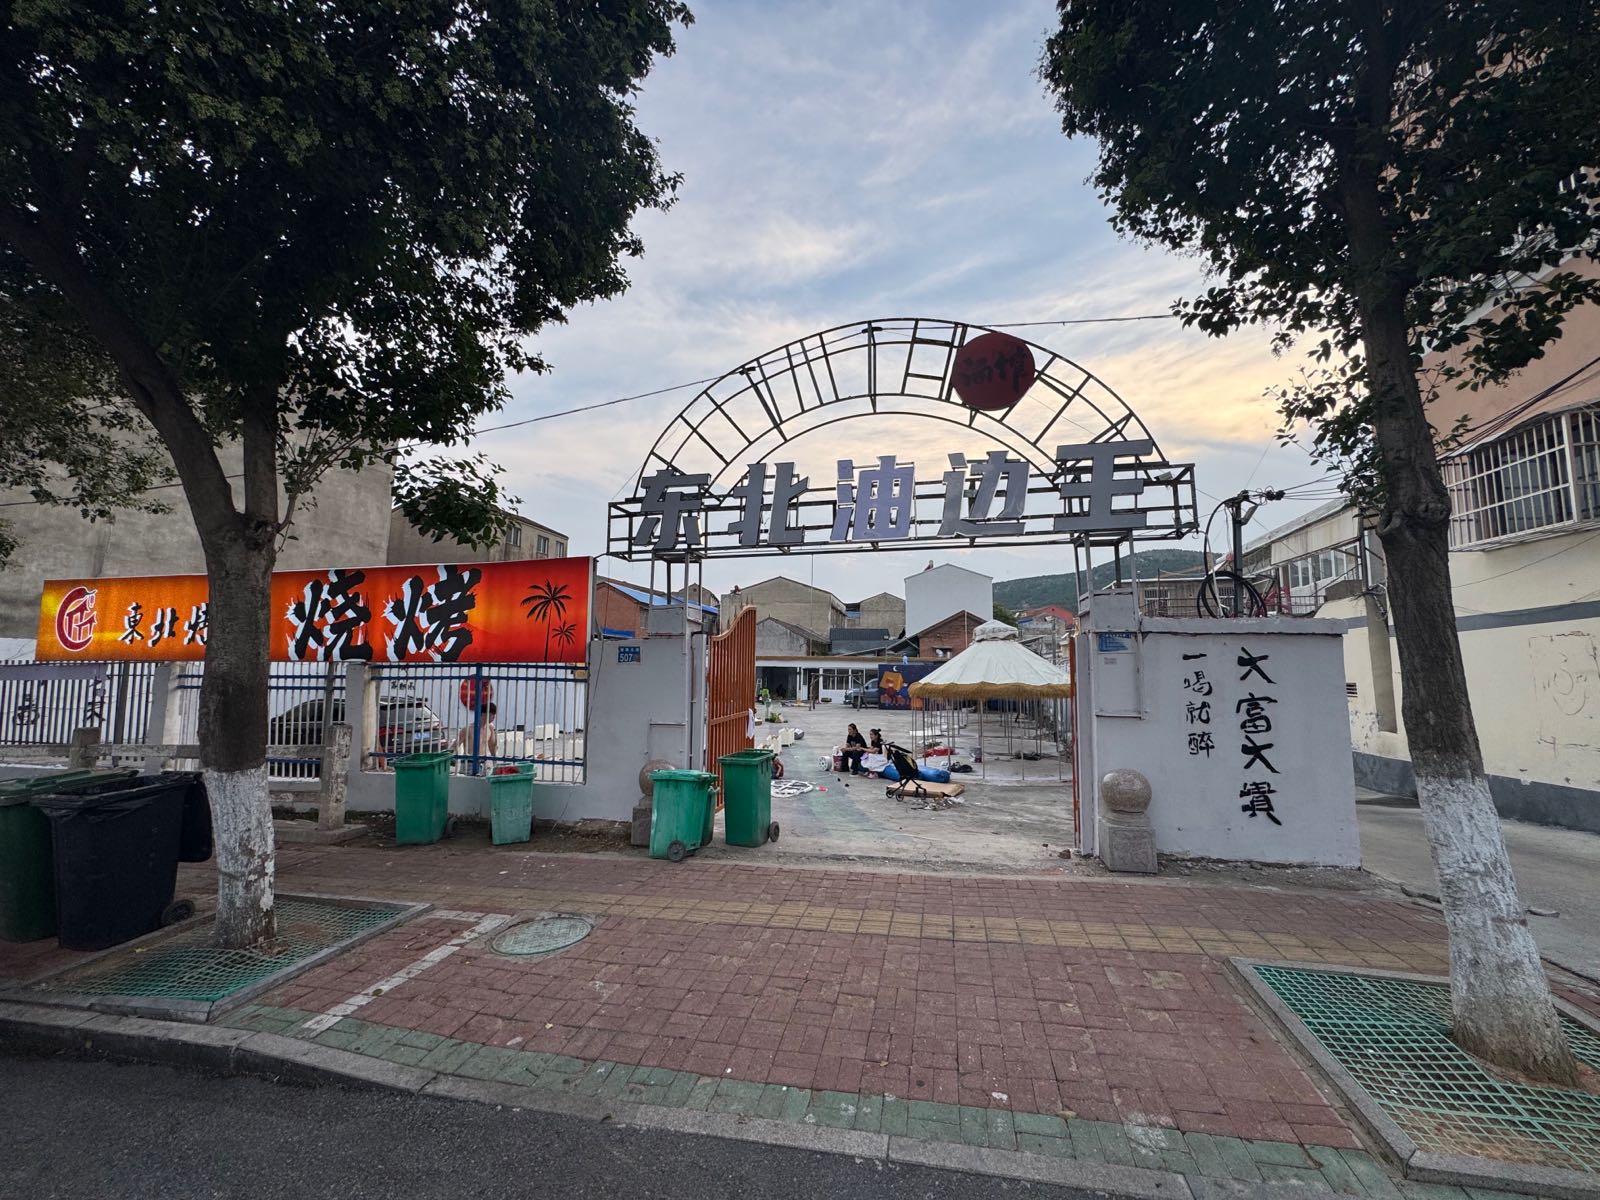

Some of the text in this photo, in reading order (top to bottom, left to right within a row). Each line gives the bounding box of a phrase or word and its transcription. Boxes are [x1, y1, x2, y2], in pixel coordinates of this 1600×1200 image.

[633, 440, 1154, 550] 东北油边王
[284, 565, 481, 662] 烧烤
[619, 653, 633, 662] 507
[1182, 653, 1215, 758] 一喝就醉
